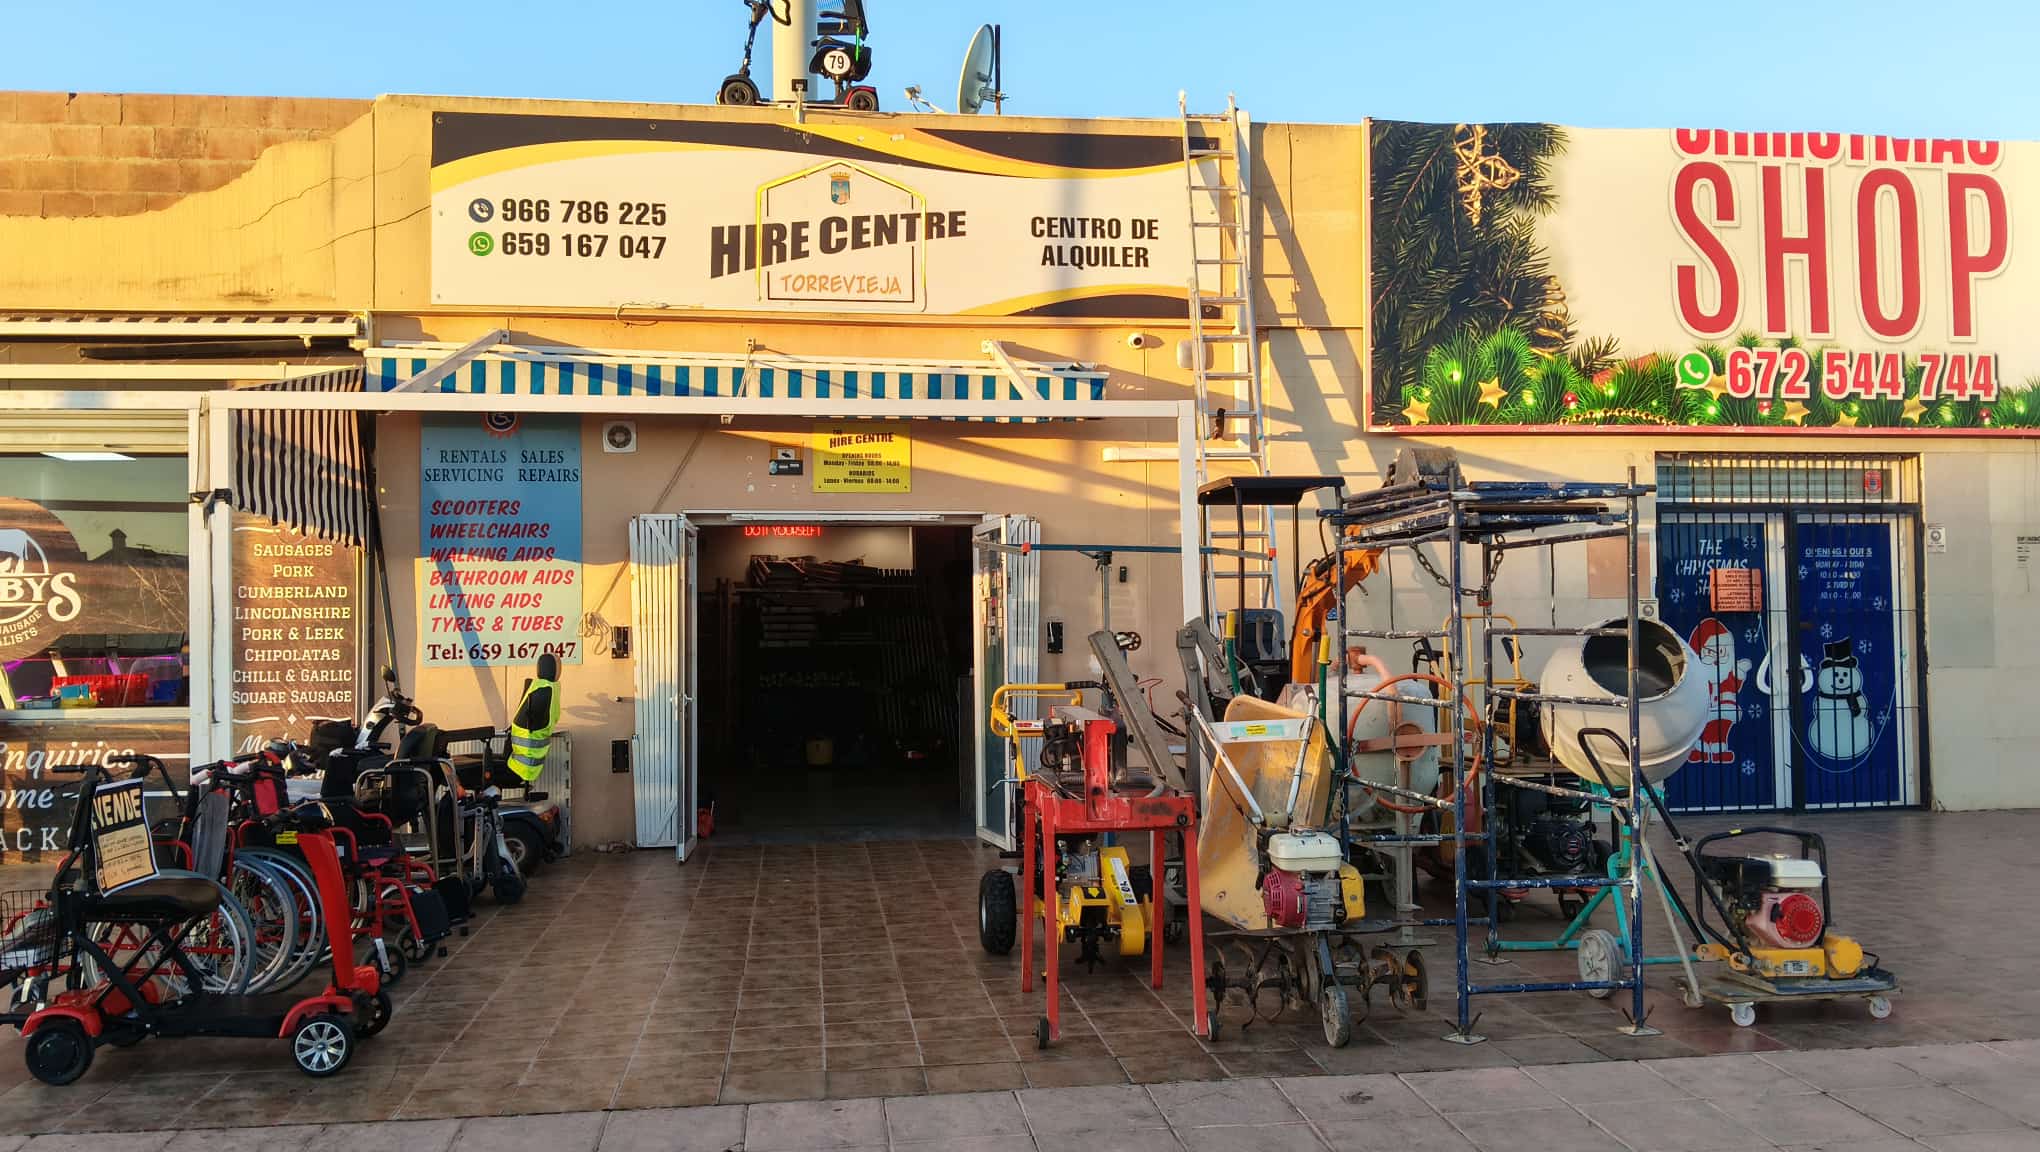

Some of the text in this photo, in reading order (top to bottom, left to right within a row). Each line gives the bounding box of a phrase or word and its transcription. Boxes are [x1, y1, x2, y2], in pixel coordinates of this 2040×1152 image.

[829, 55, 845, 70] 79
[502, 198, 666, 226] 966 786 225
[1031, 216, 1159, 240] CENTRO DE
[502, 232, 667, 259] 659 167 047
[709, 210, 966, 279] HIRE CENTRE
[1674, 161, 2008, 337] SHOP
[1041, 245, 1149, 270] ALQUILER
[780, 274, 902, 295] TORREVIEJA
[1728, 350, 1996, 398] 672 544 744
[829, 432, 895, 448] HIRE CENTRE
[439, 449, 564, 464] RENTALS SALES
[424, 468, 579, 482] SERVICING REPAIRS
[430, 499, 521, 515] SCOOTERS
[430, 522, 551, 539] WHEELCHAIRS
[253, 543, 333, 557] SAUSAGES
[430, 546, 556, 563] WALKING AIDS
[1699, 539, 1723, 556] THE
[273, 564, 314, 578] PORK
[430, 569, 575, 586] BATHROOM AIDS
[238, 585, 348, 599] CUMBERLAND
[429, 592, 543, 609] LIFTING AIDS
[234, 606, 351, 620] LINCOLNSHIRE
[0, 609, 42, 635] AUSAGE
[431, 615, 564, 632] TYRES & TUBES
[0, 626, 39, 647] LISTS
[242, 626, 345, 641] PORK & LEEK
[244, 648, 341, 662] CHIPOLATAS
[427, 641, 577, 661] Tel: 659 167 047
[232, 668, 352, 683] CHILLI & GARLIC
[232, 689, 352, 704] SQUARE SAUSAGE
